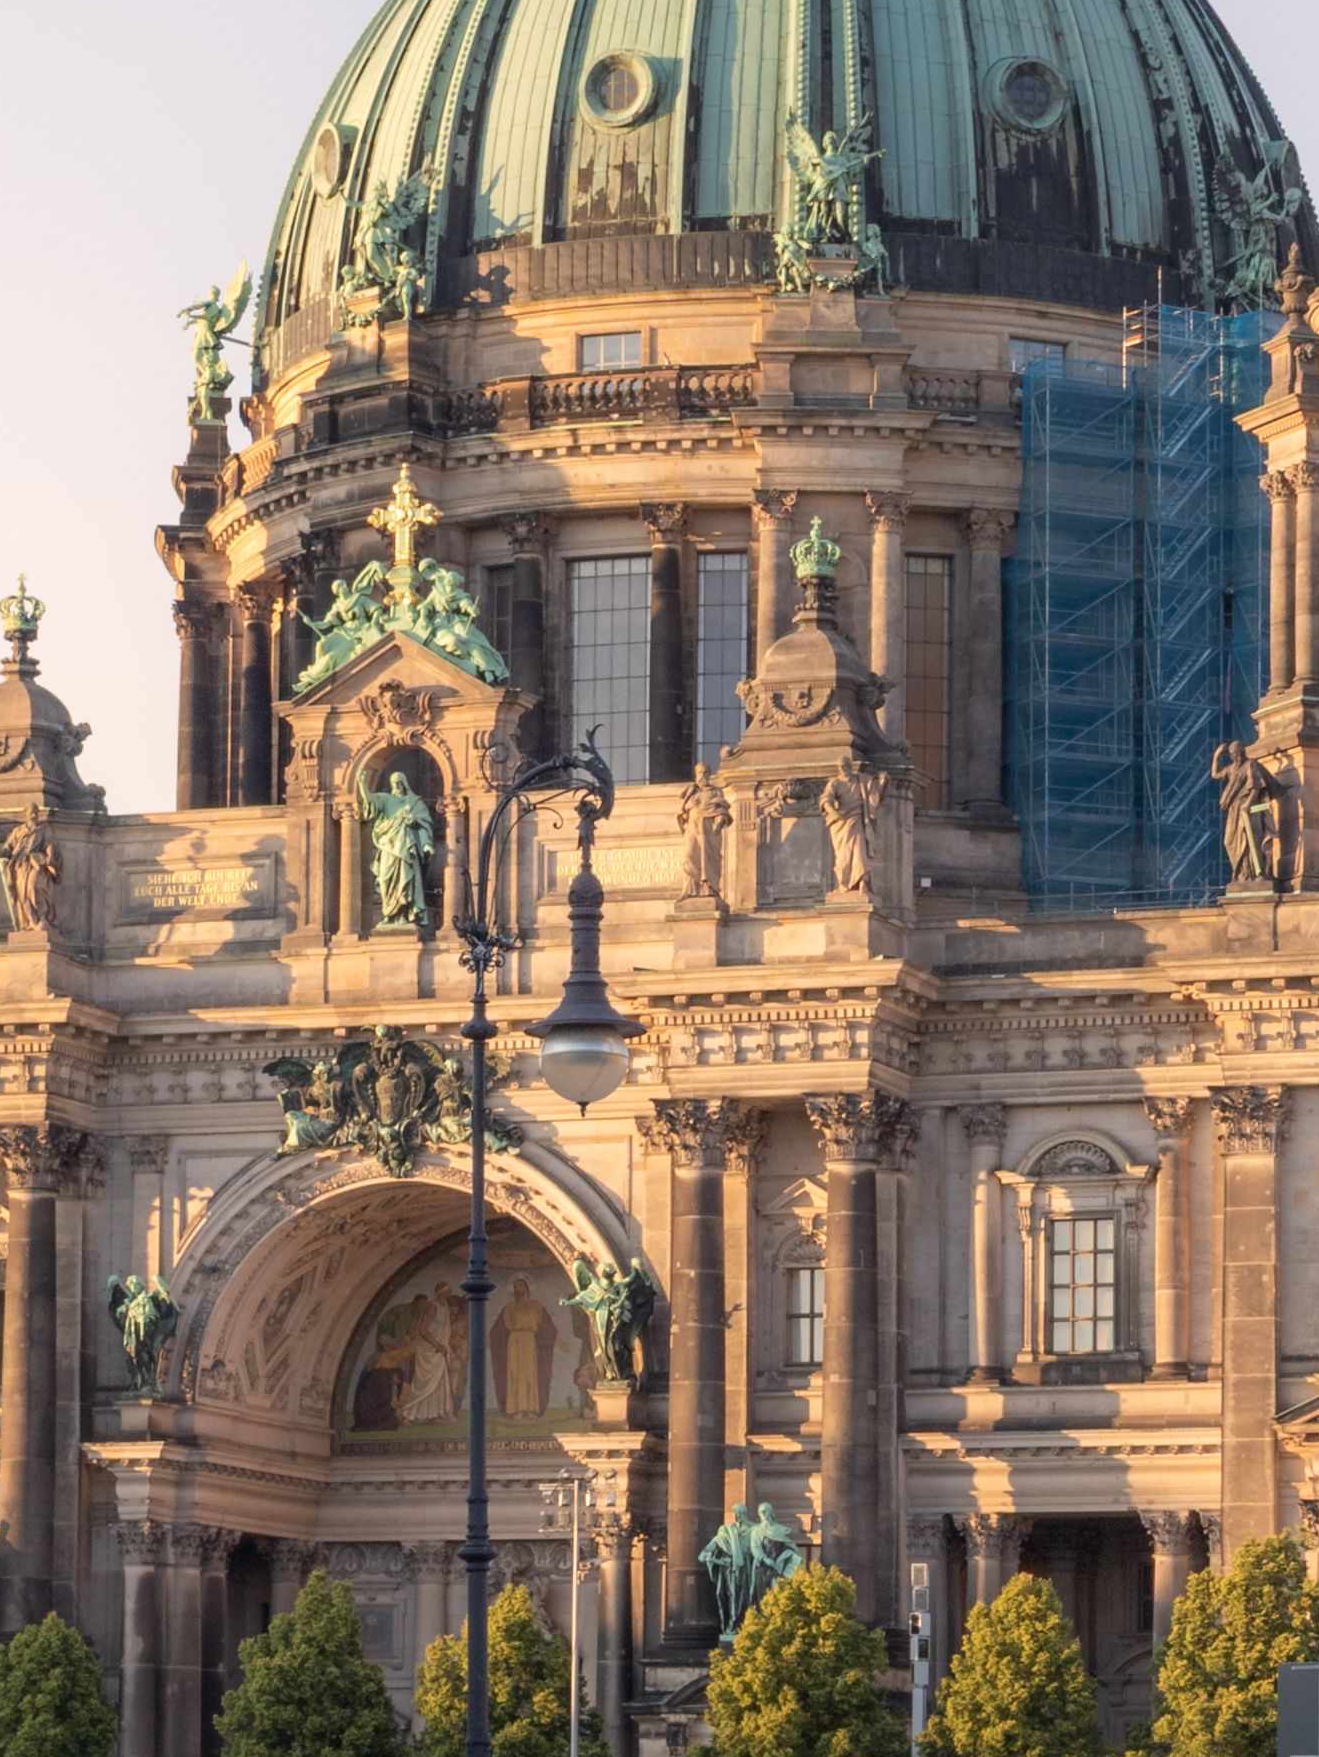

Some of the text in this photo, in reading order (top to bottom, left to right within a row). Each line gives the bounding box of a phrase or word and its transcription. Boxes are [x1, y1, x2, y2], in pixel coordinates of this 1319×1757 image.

[183, 872, 202, 883] ICH
[205, 870, 224, 882] BIN
[228, 869, 246, 881] BEI
[557, 865, 580, 875] DER
[135, 880, 258, 897] EUCH ALLE TAGE BIS AN
[153, 896, 175, 907] DER
[178, 894, 205, 906] WELT
